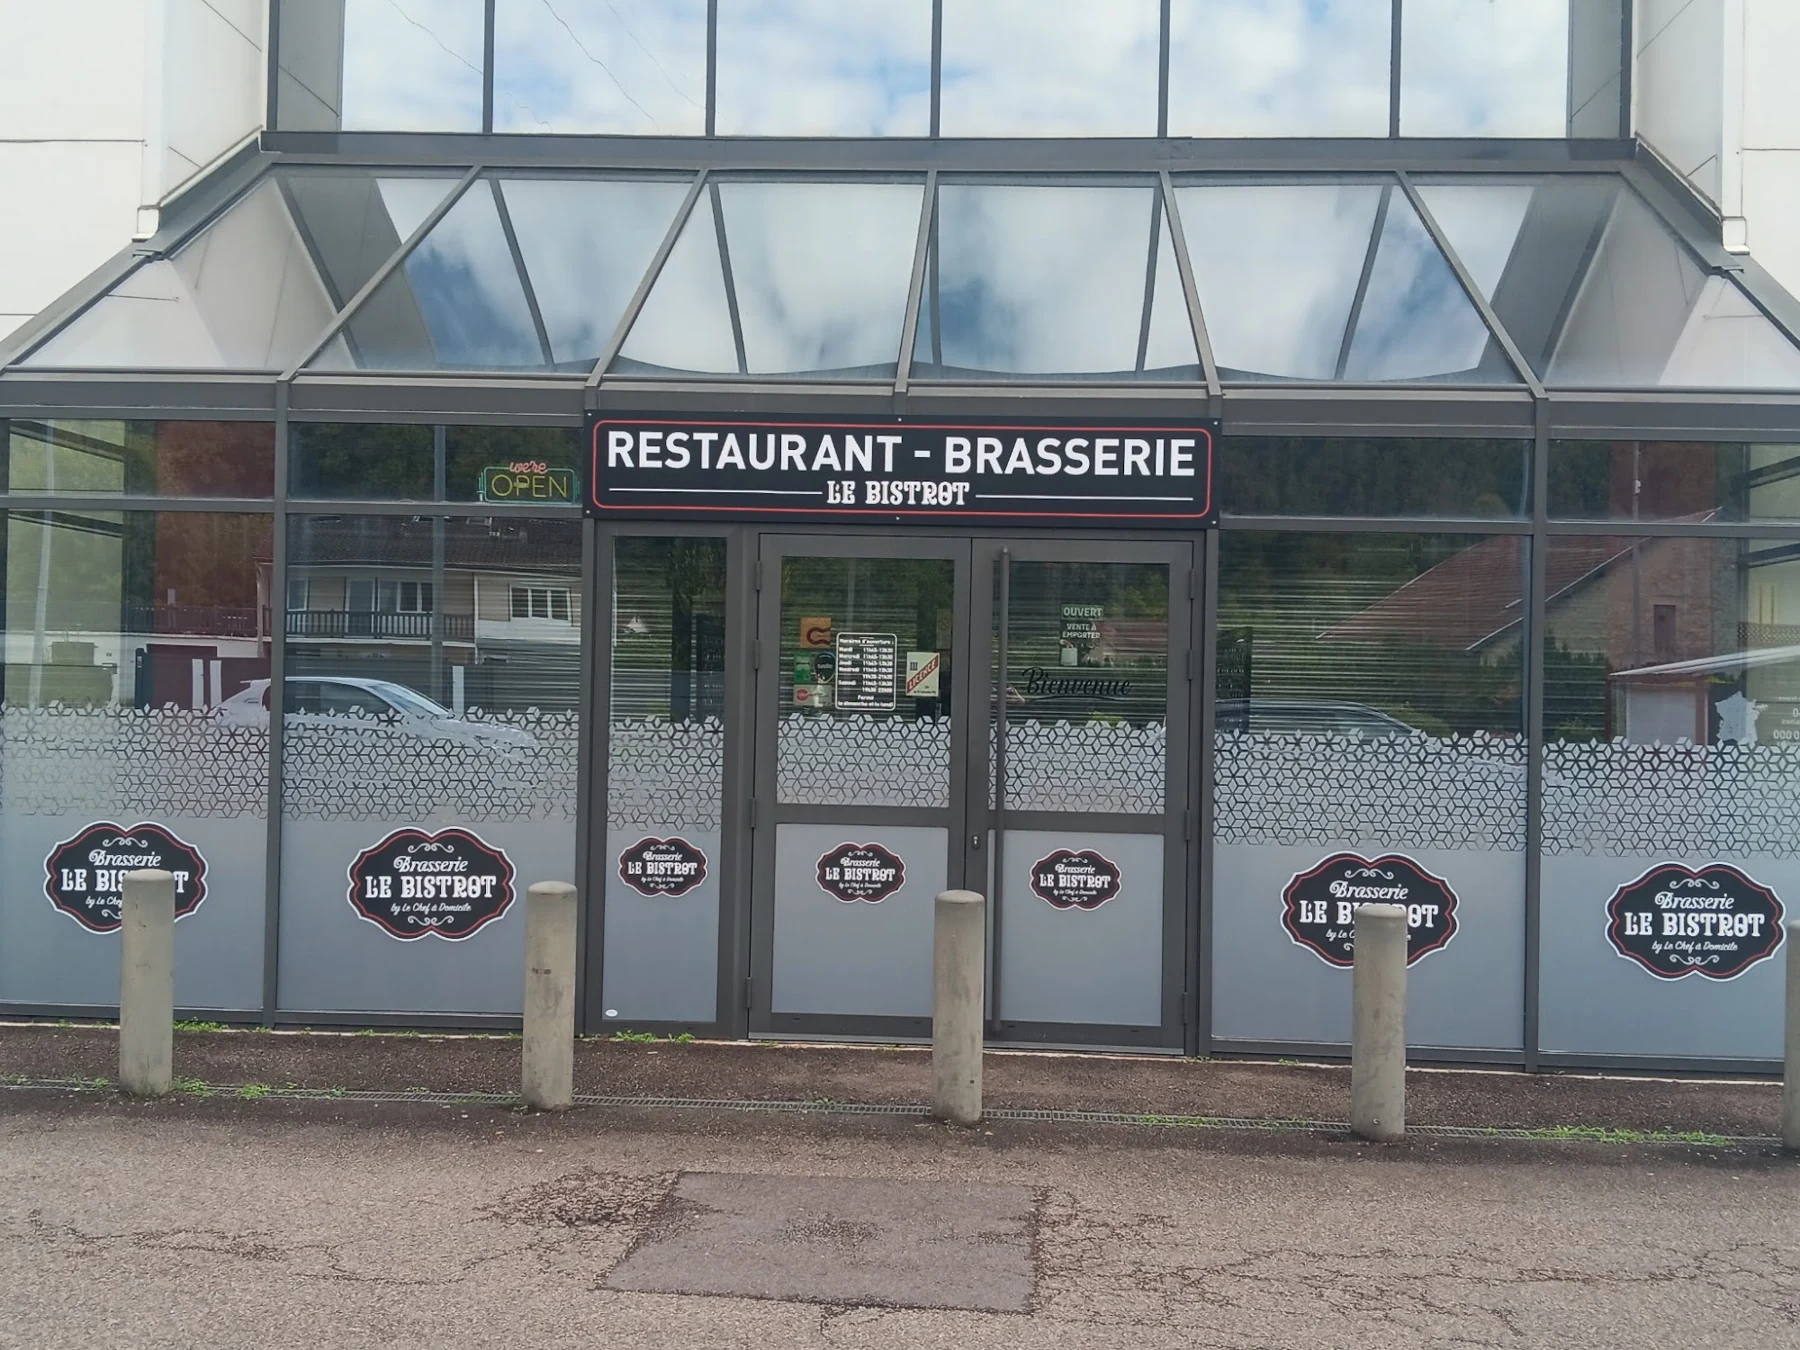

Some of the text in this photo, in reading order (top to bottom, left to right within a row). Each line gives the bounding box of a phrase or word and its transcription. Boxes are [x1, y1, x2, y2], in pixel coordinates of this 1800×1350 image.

[608, 431, 902, 472] RESTAURANT
[945, 437, 1195, 476] BRASSERIE
[491, 474, 567, 498] OPEN
[826, 480, 970, 505] LE BISTROT
[1063, 607, 1103, 617] OUVERT
[1066, 623, 1090, 631] VENTE
[908, 659, 936, 690] LICENCE
[1021, 666, 1133, 696] Bienvenue
[88, 849, 162, 867] Brasserie
[393, 856, 469, 873] Brasserie
[627, 862, 698, 875] LE BISTROT
[825, 867, 895, 881] LE BISTROT
[61, 868, 87, 892] LE
[365, 875, 497, 899] LE BISTROT
[1039, 874, 1111, 888] LE BISTROT
[1329, 880, 1409, 900] Brasserie
[390, 903, 401, 915] by
[412, 902, 430, 915] Chef
[438, 902, 472, 912] Domicile
[1654, 891, 1735, 910] Brasserie
[1299, 900, 1328, 924] LE
[1624, 912, 1765, 937] LE BISTROT
[1326, 929, 1337, 942] by
[1652, 941, 1662, 954] by
[1675, 941, 1695, 954] Chef
[1703, 941, 1738, 951] Domicile
